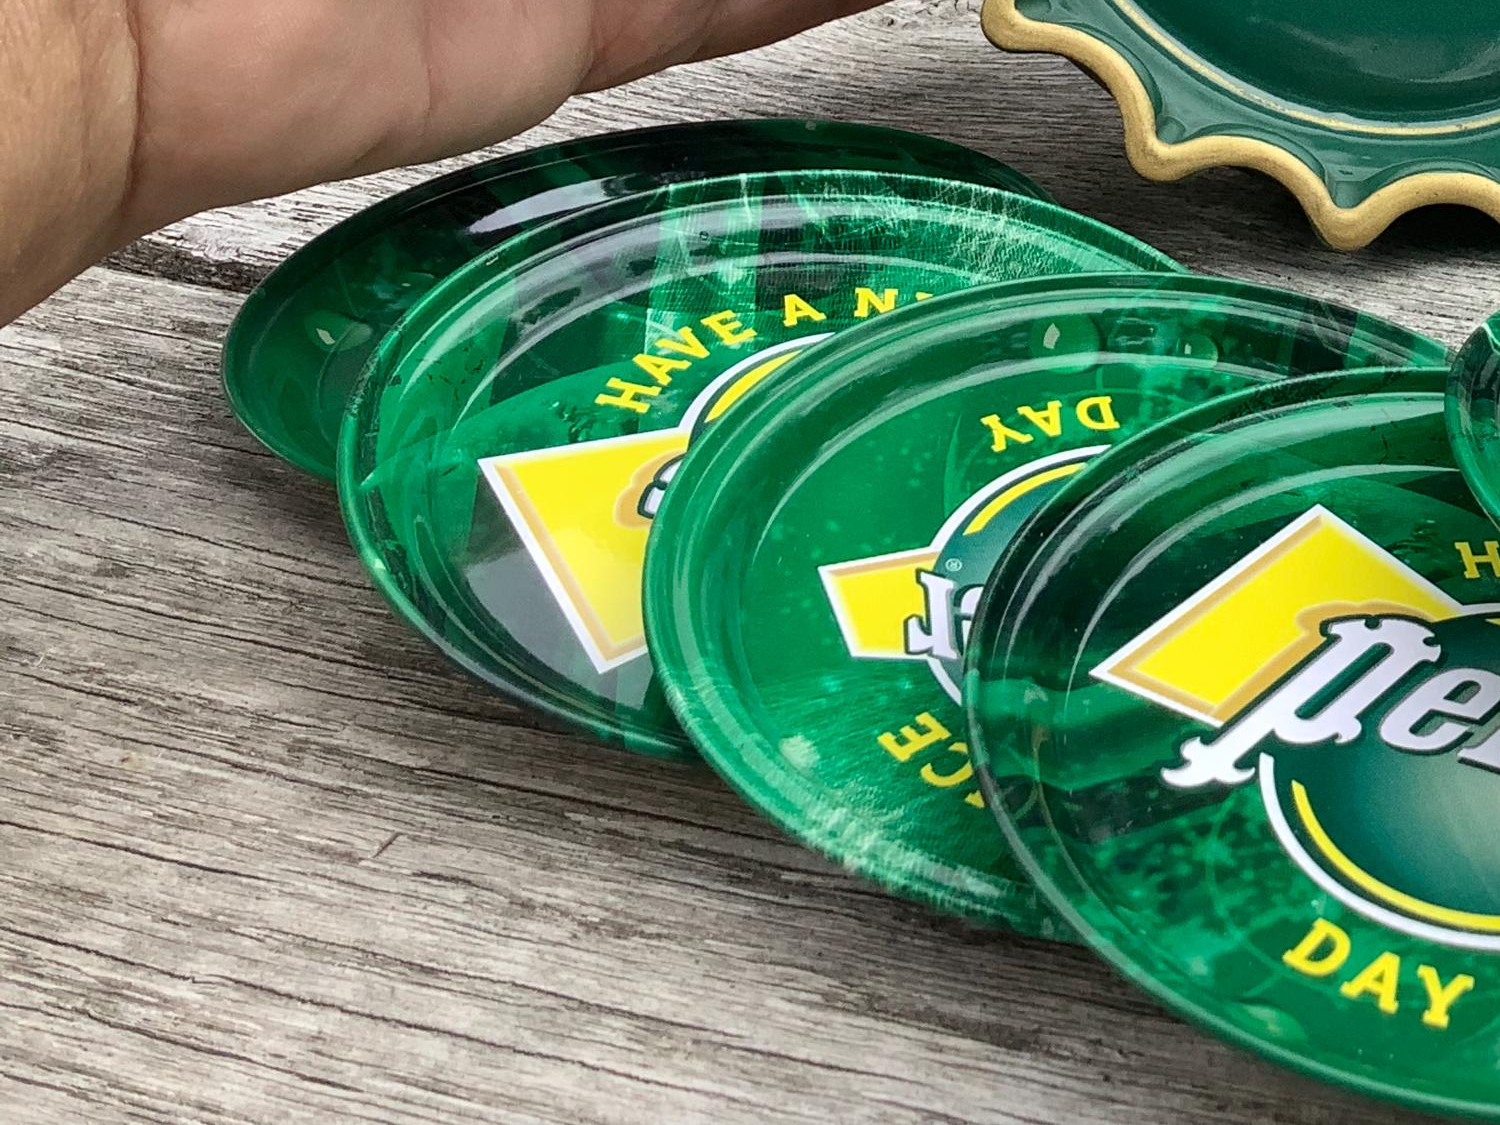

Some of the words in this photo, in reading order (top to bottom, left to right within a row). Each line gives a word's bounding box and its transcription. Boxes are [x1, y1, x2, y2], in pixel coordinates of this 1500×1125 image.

[595, 309, 757, 414] HAVE
[783, 293, 827, 327] A
[979, 395, 1121, 453] DAY
[876, 711, 986, 810] CE
[1281, 918, 1475, 1033] DAY
